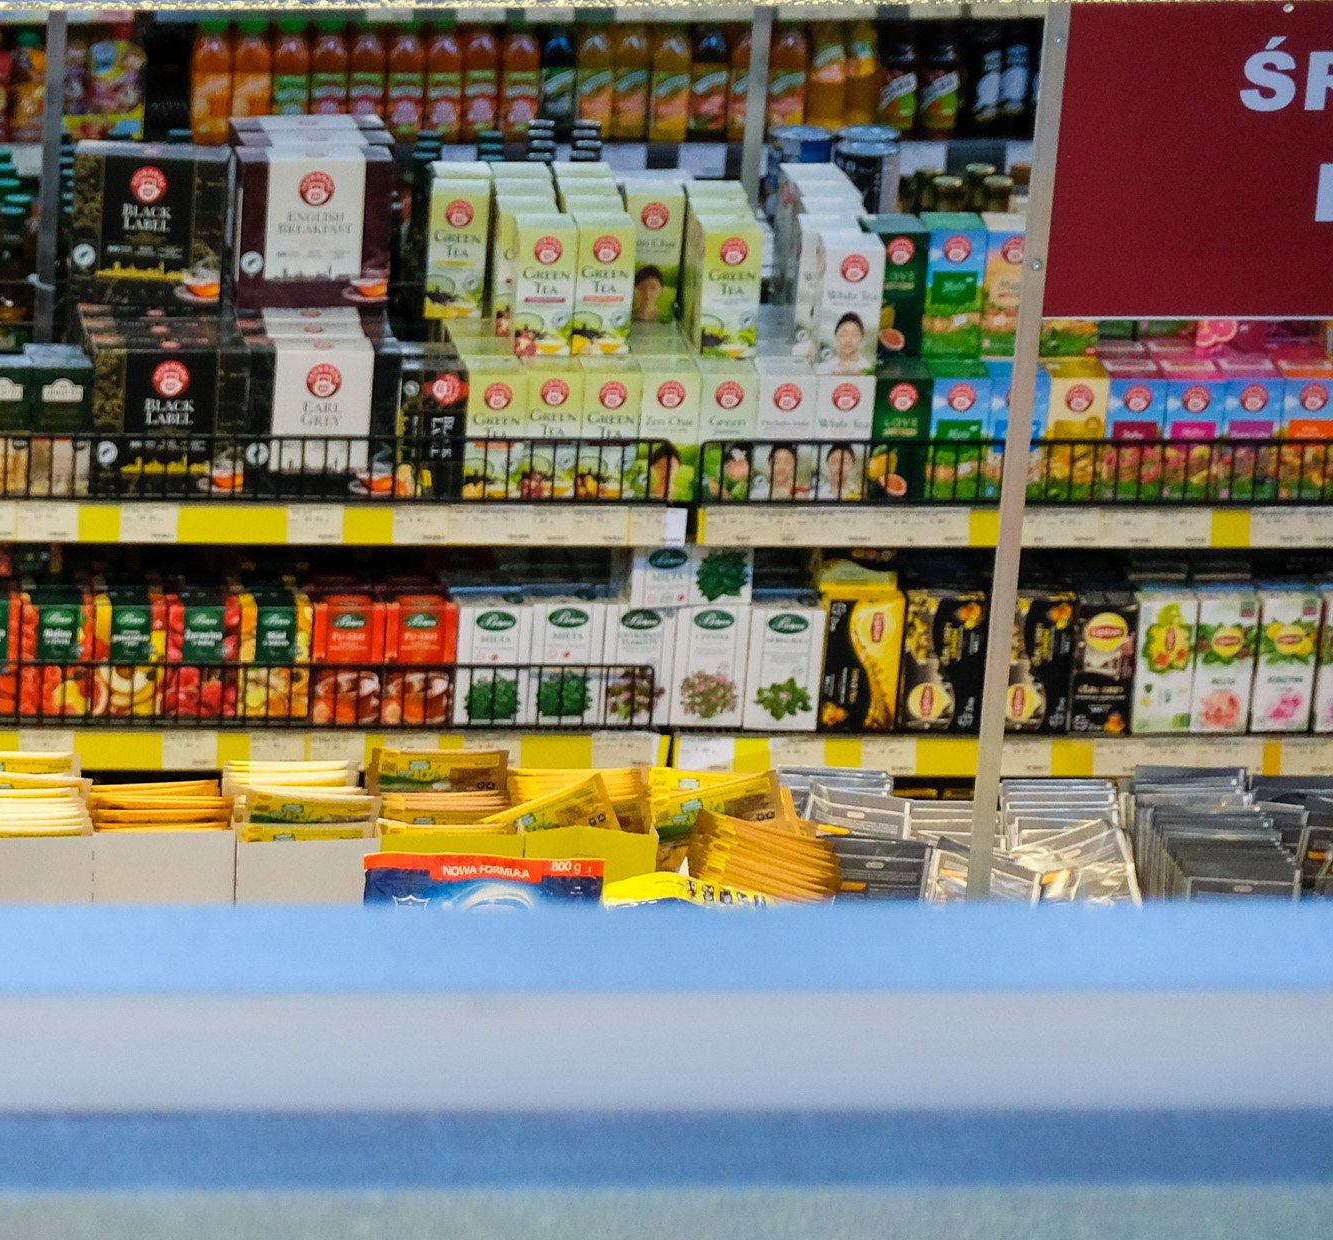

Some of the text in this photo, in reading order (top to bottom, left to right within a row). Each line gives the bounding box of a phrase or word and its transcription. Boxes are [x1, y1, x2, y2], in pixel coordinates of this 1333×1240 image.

[122, 203, 171, 219] BLACK
[122, 218, 171, 232] LABEL
[433, 230, 486, 247] GREEN
[522, 269, 570, 283] GREEN
[580, 266, 628, 281] GREEN
[708, 270, 757, 284] GREEN
[536, 283, 558, 295] TEA
[595, 280, 617, 295] TEA
[443, 864, 531, 880] NOWA FORMUŁA
[551, 861, 571, 872] 800
